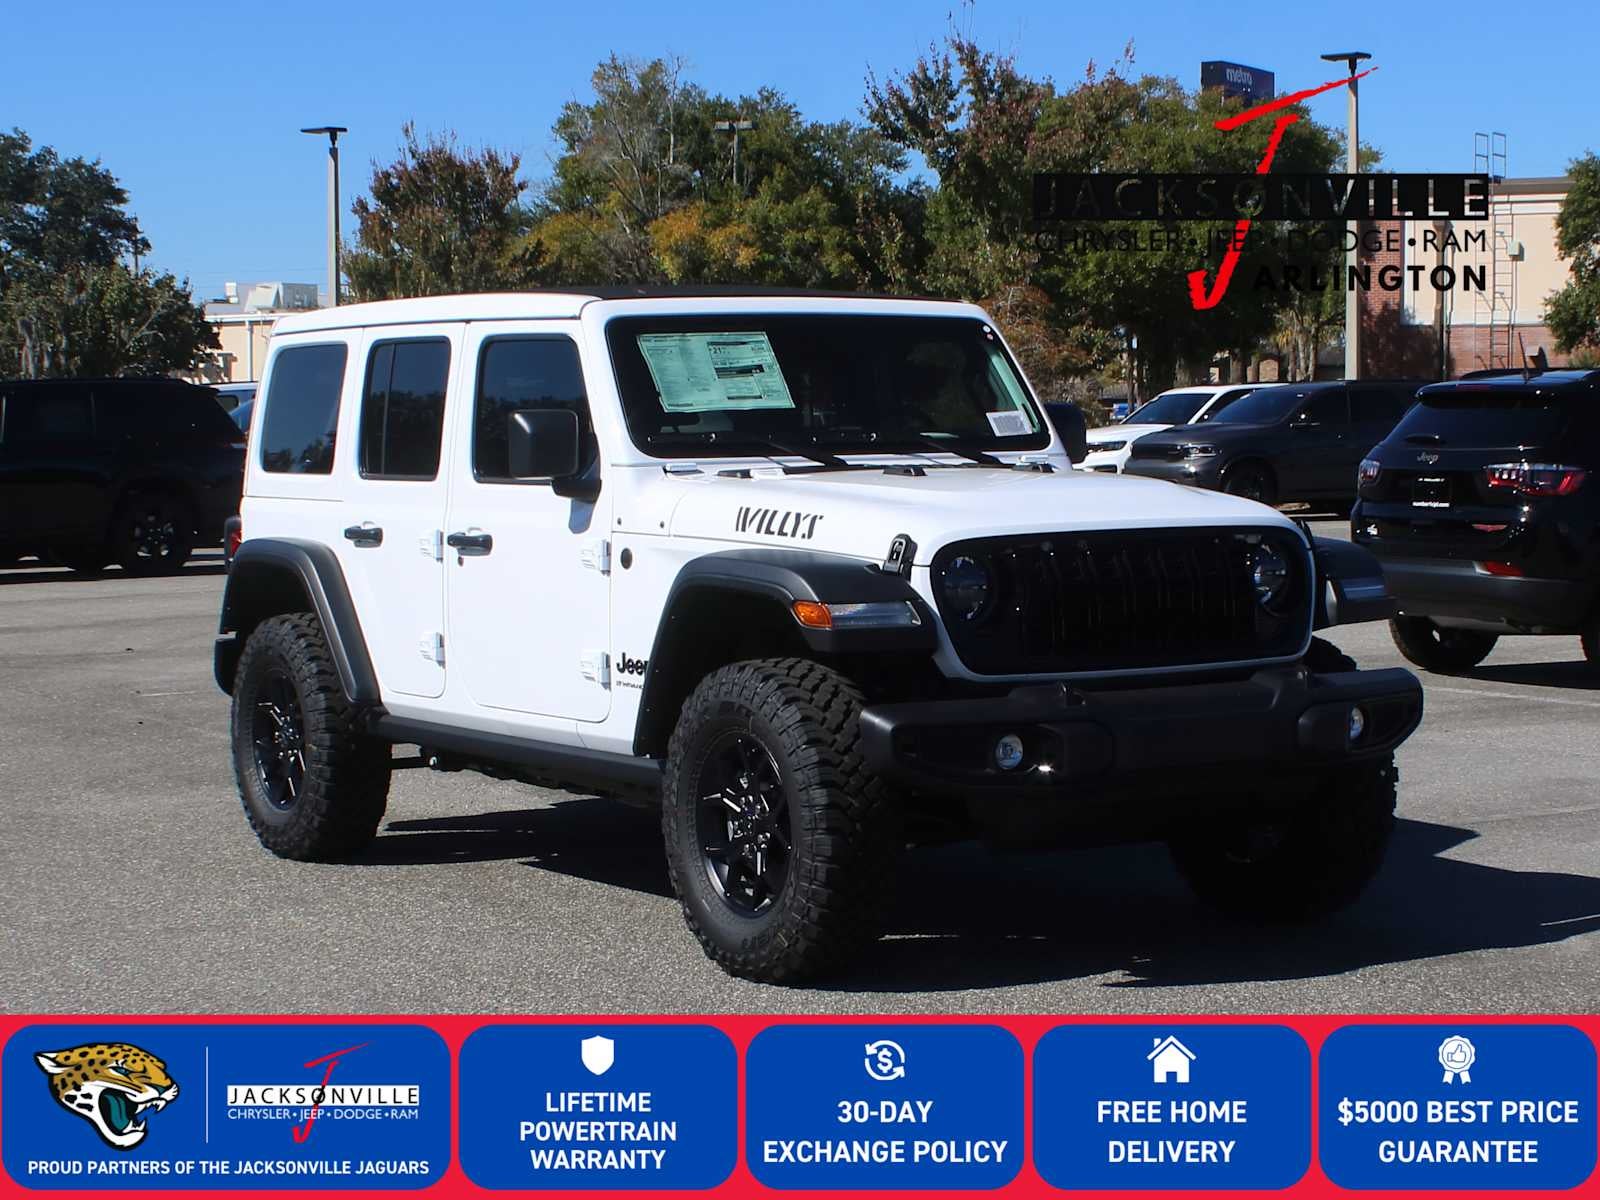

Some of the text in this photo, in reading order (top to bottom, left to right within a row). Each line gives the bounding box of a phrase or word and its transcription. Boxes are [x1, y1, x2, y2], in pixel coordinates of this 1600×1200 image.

[1226, 68, 1253, 86] metro
[1416, 451, 1439, 463] Jeep
[735, 505, 825, 540] WILLYS
